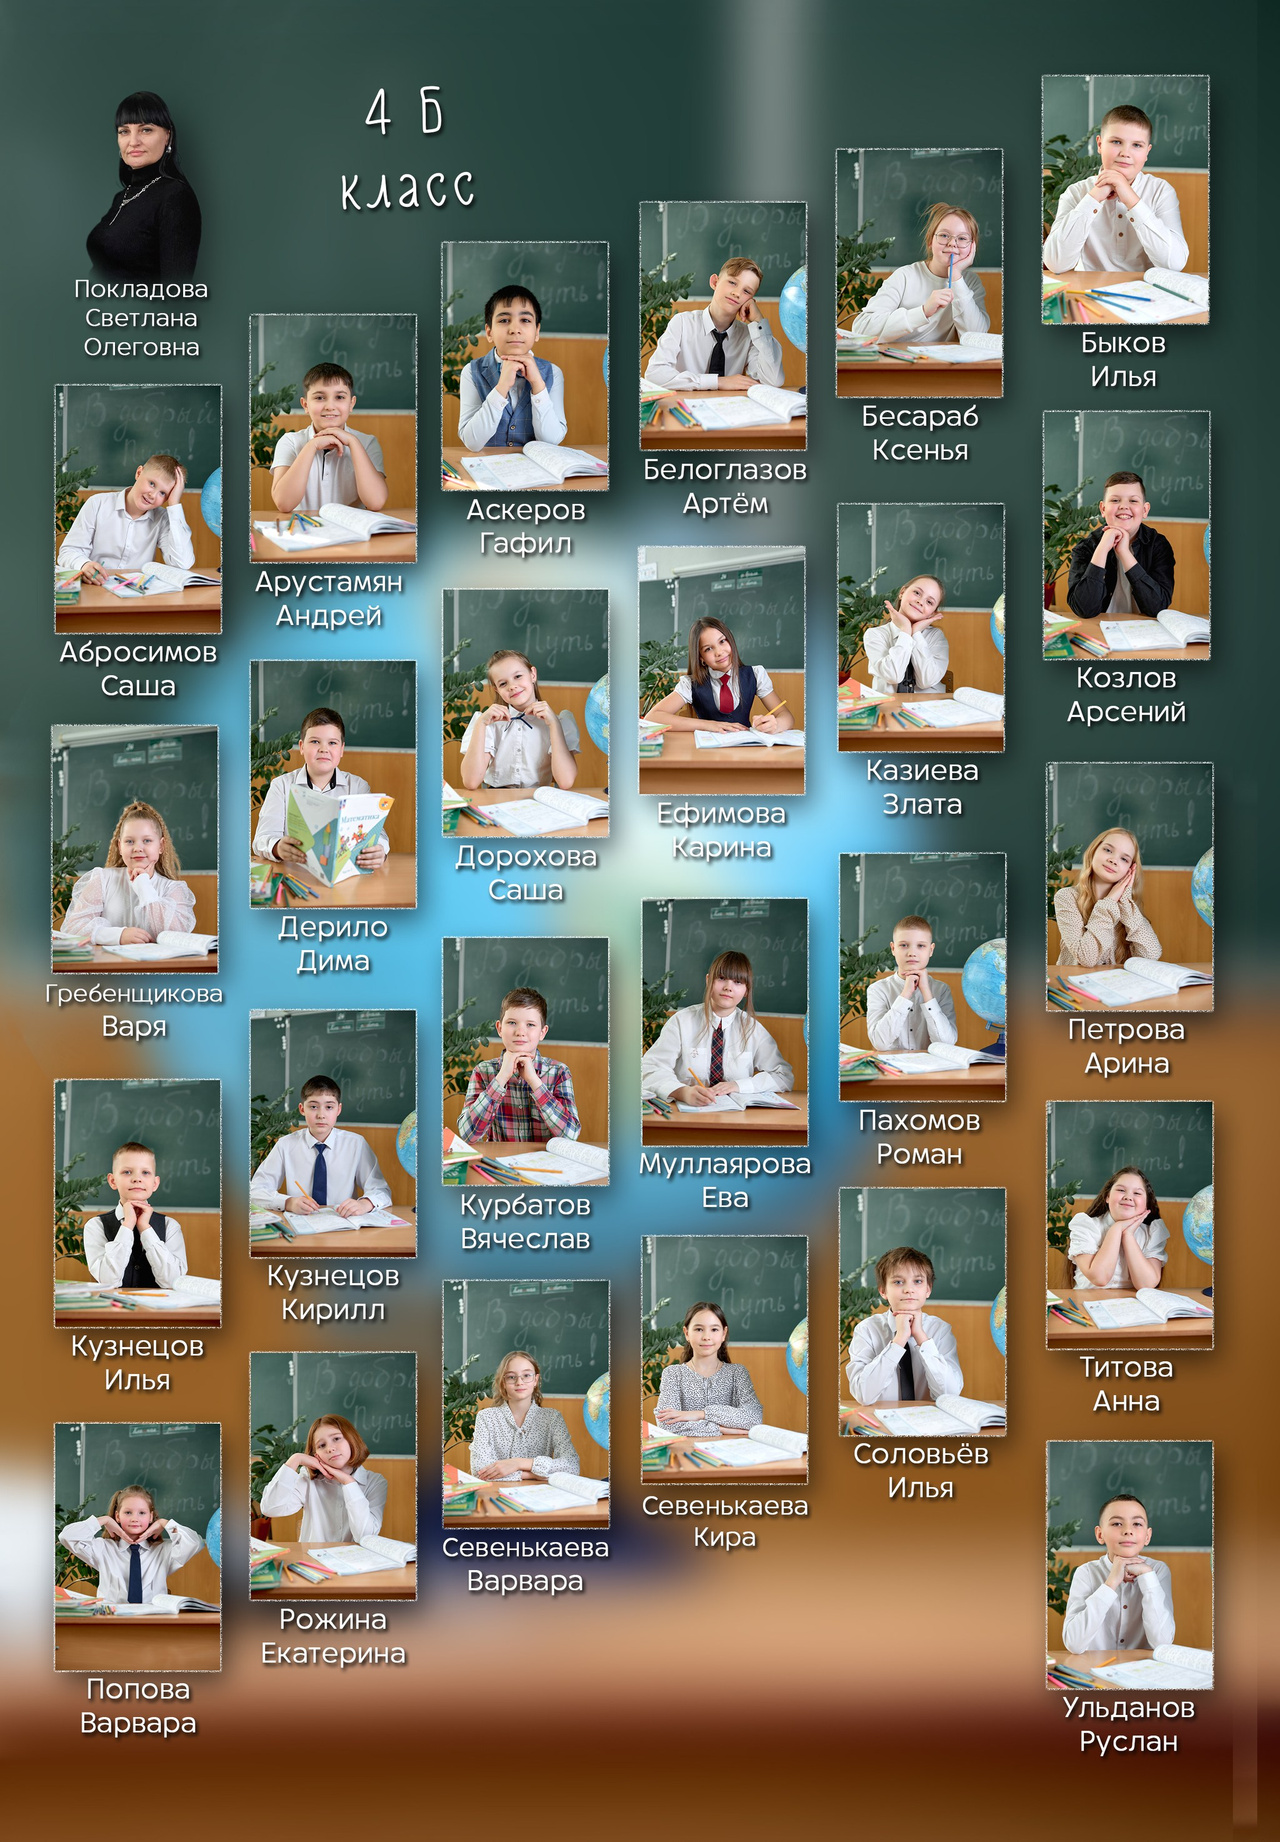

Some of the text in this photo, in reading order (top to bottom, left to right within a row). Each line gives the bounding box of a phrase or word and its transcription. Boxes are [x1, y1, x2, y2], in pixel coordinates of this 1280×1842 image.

[873, 161, 908, 207] В
[75, 391, 217, 442] В добрый
[1091, 416, 1125, 459] В
[883, 508, 917, 552] В
[76, 768, 111, 814] В
[1065, 764, 1099, 807] В
[341, 814, 380, 824] Математика
[874, 866, 908, 909] В
[676, 920, 708, 958] В
[295, 1034, 324, 1072] В
[80, 1091, 119, 1140] В
[876, 1193, 911, 1240] В
[664, 1238, 699, 1282] В
[473, 1298, 507, 1340] В
[305, 1359, 337, 1401] В
[93, 1439, 126, 1482] В
